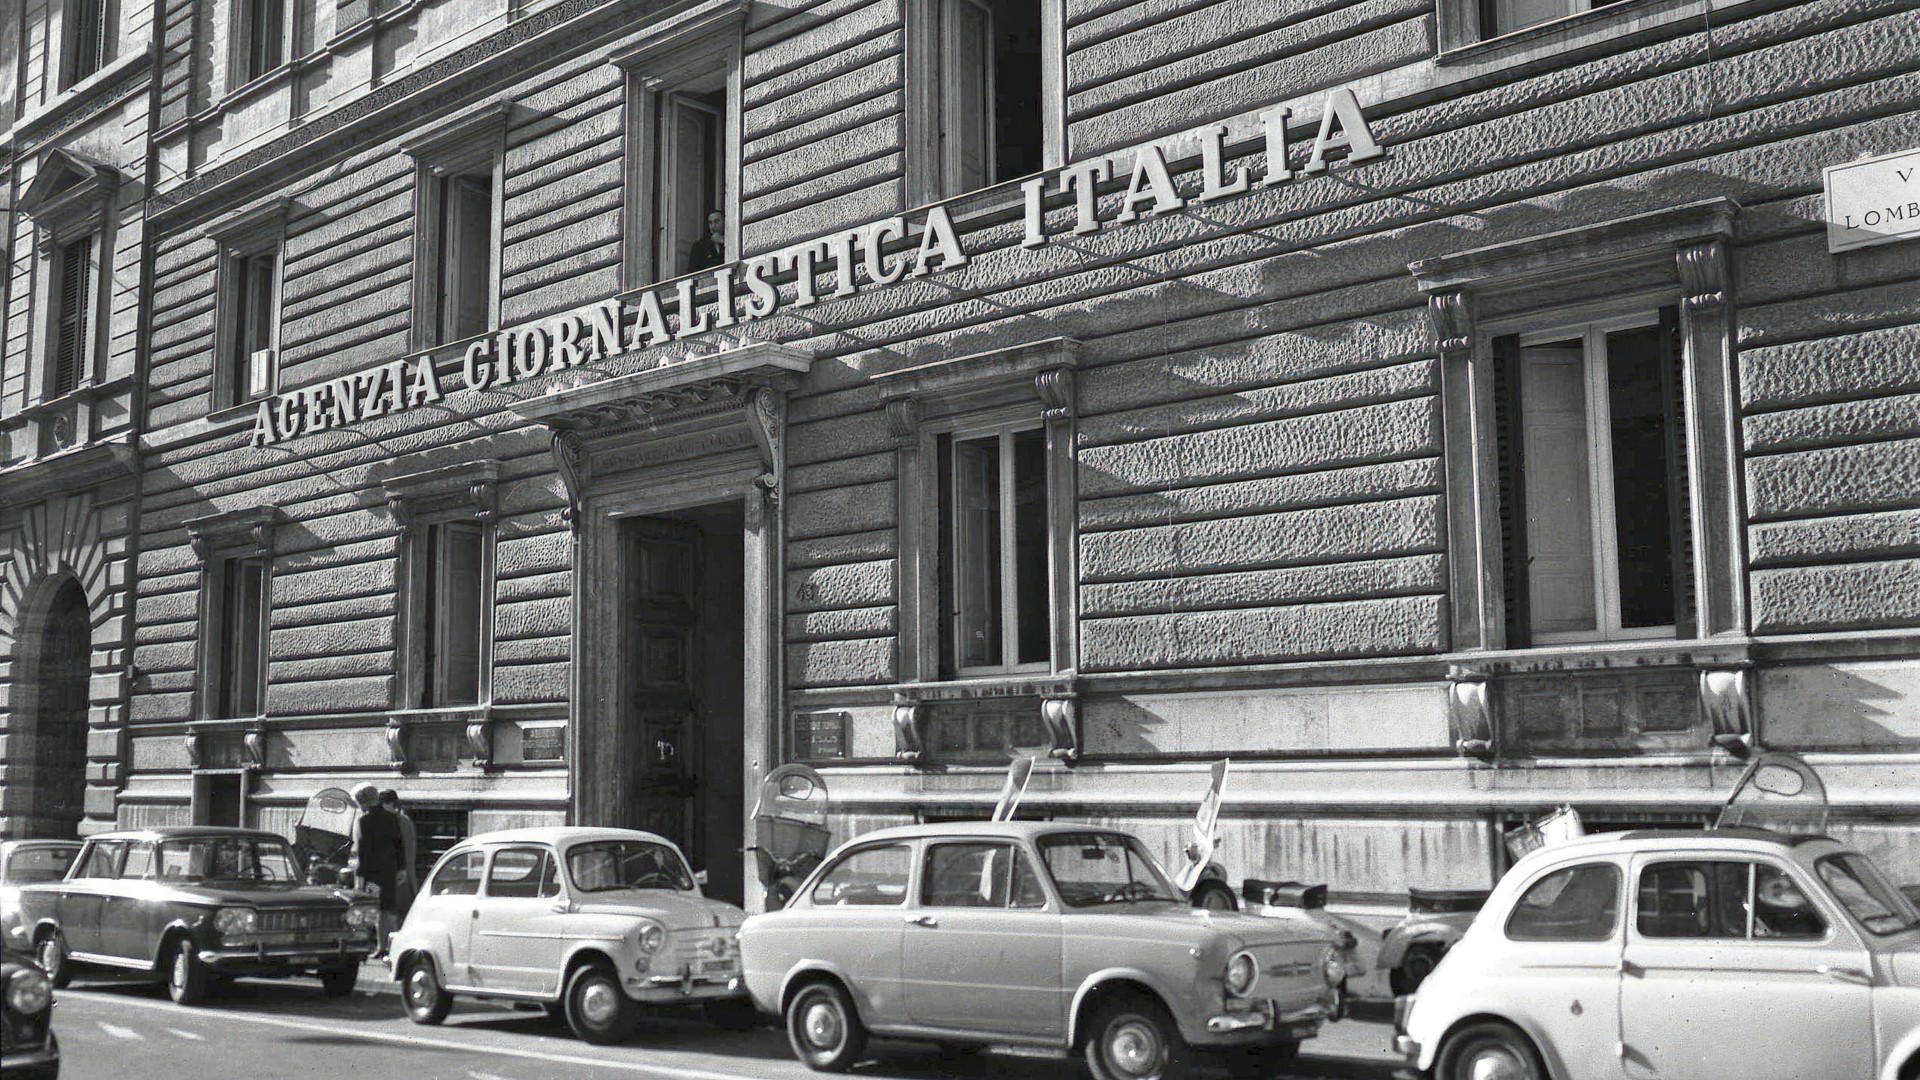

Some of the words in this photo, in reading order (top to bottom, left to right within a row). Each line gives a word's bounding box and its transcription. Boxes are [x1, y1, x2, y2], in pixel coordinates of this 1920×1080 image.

[250, 355, 442, 447] AGENZIA
[463, 206, 968, 391] GIORNALISTICA
[1021, 88, 1384, 249] ITALIA
[1845, 202, 1920, 230] LOMB
